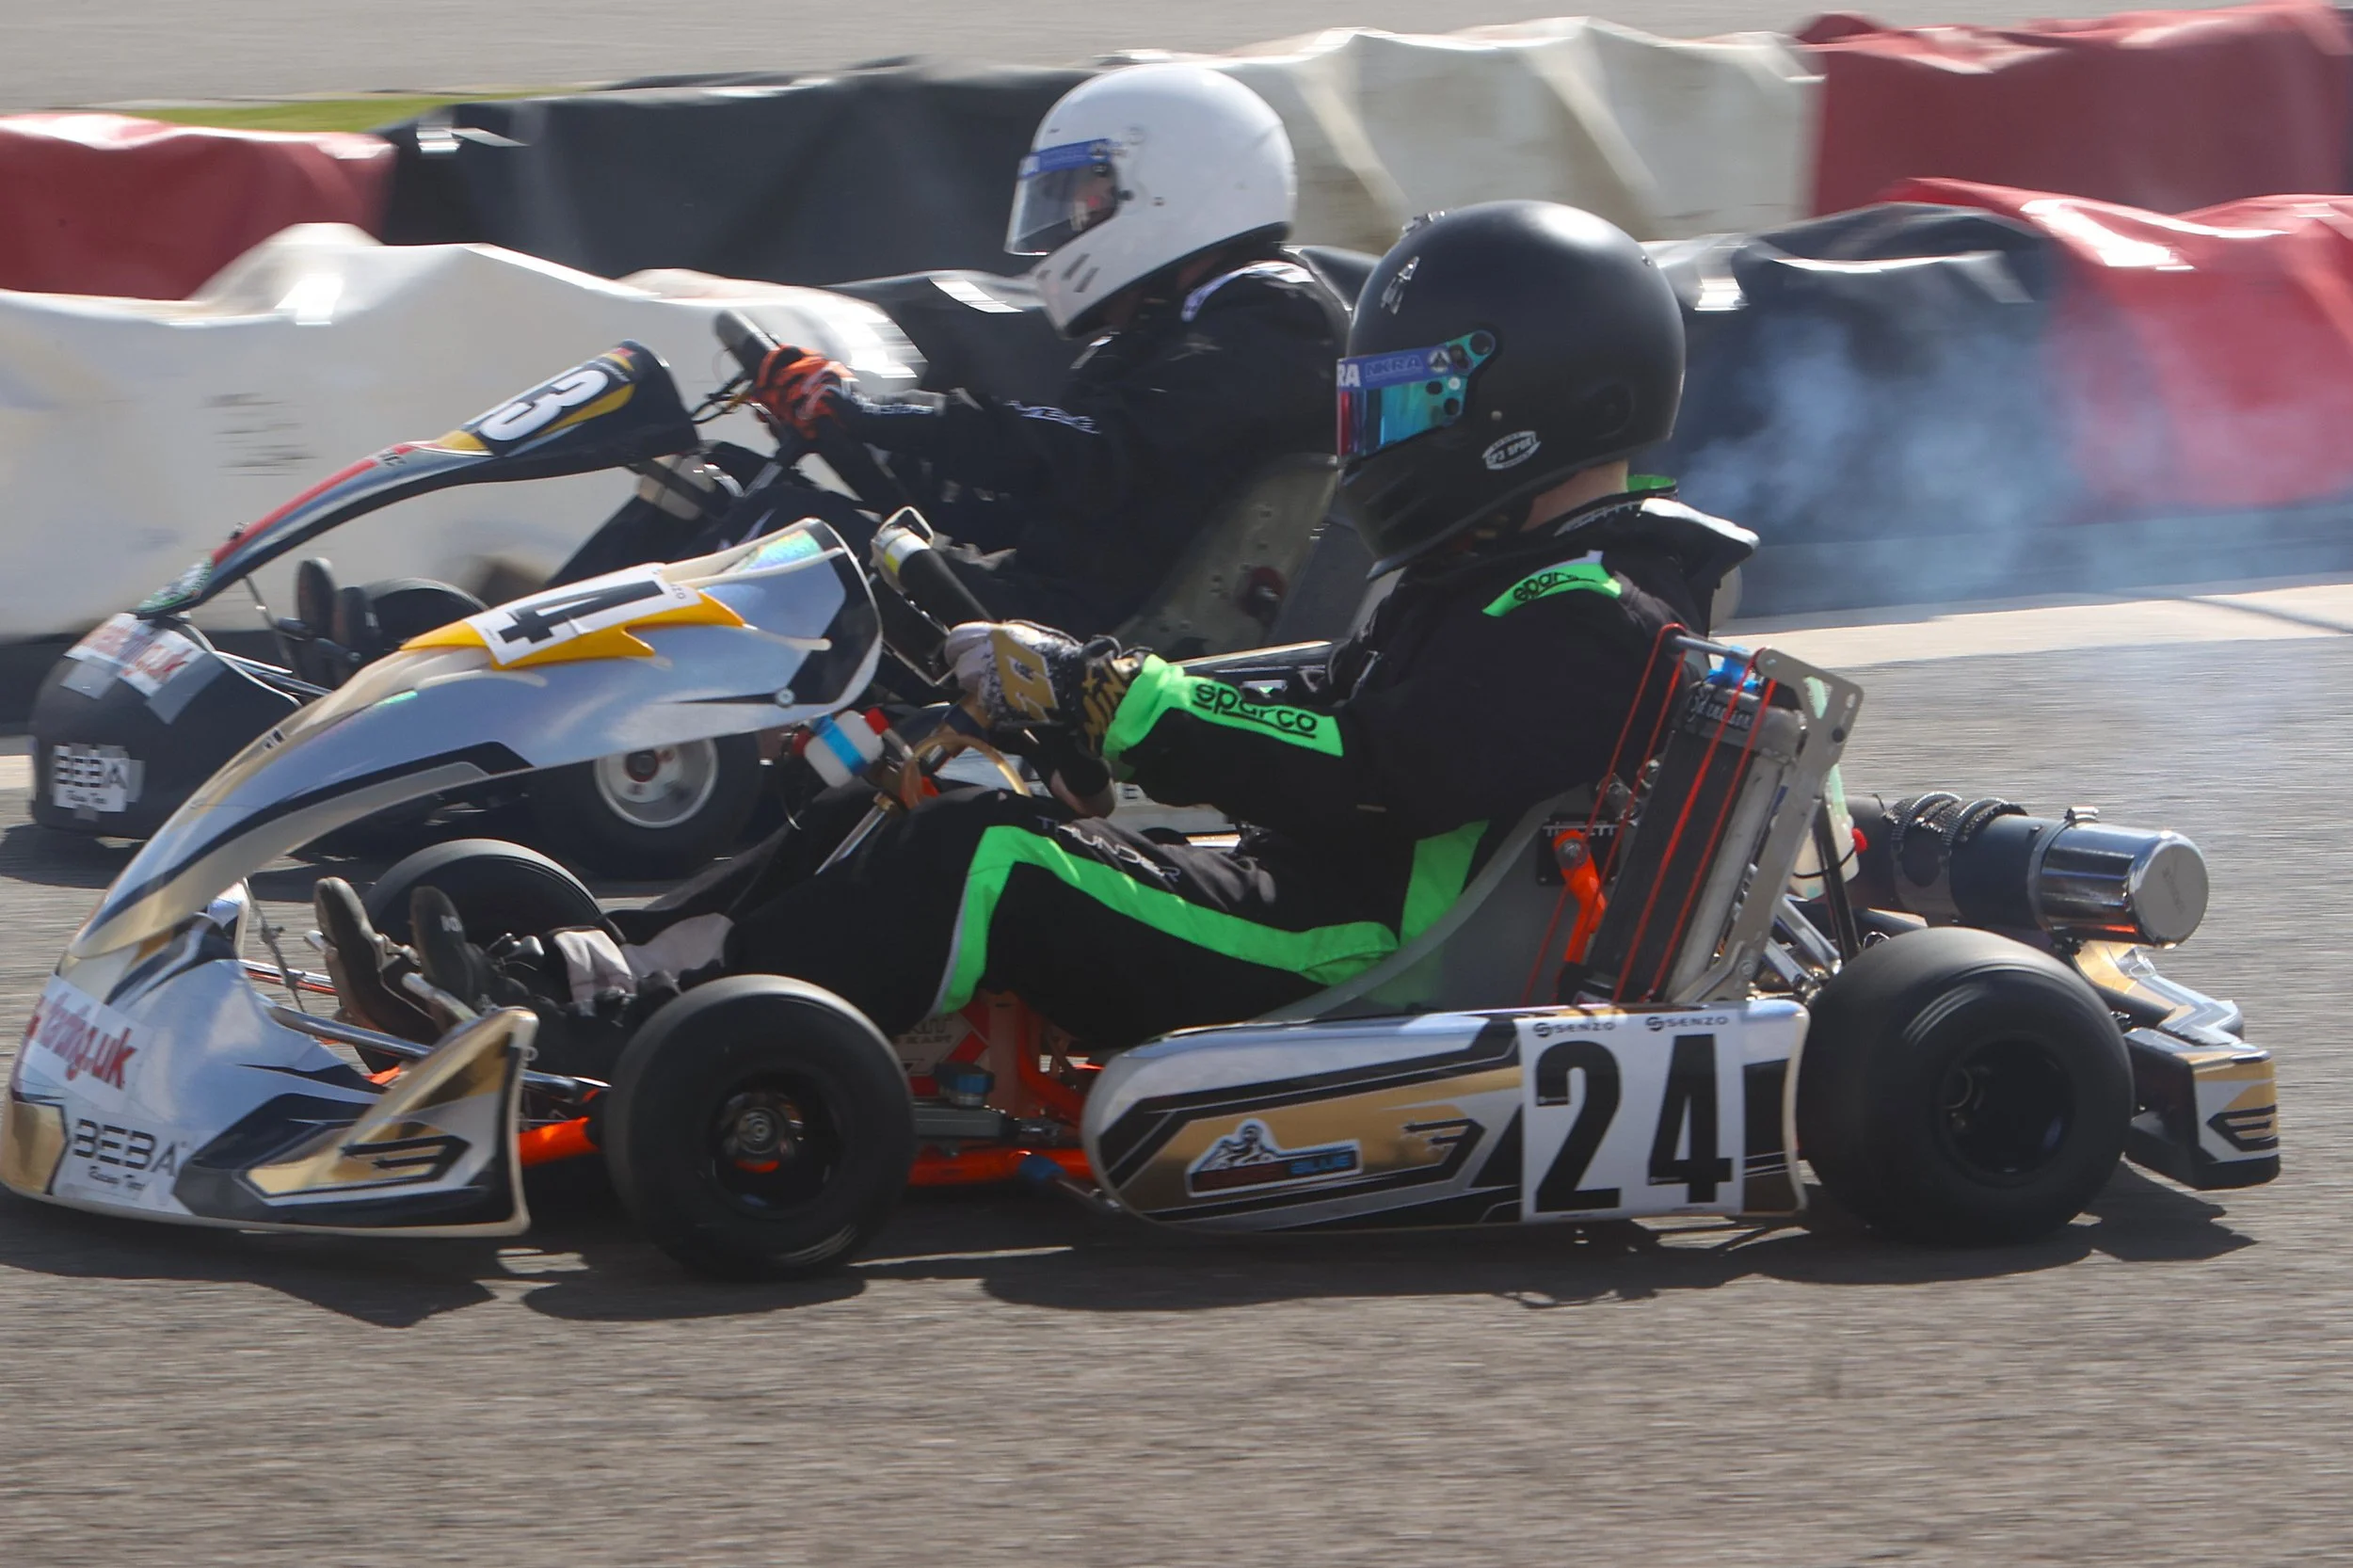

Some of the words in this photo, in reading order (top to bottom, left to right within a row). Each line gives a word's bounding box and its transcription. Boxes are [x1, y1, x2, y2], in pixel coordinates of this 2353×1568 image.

[1366, 354, 1424, 376] NKRA
[1193, 681, 1318, 740] sparco
[1554, 1021, 1617, 1033] SENZO
[1666, 1016, 1729, 1028] SENZO
[73, 1117, 178, 1177] BEBA
[1535, 1033, 1734, 1213] 24
